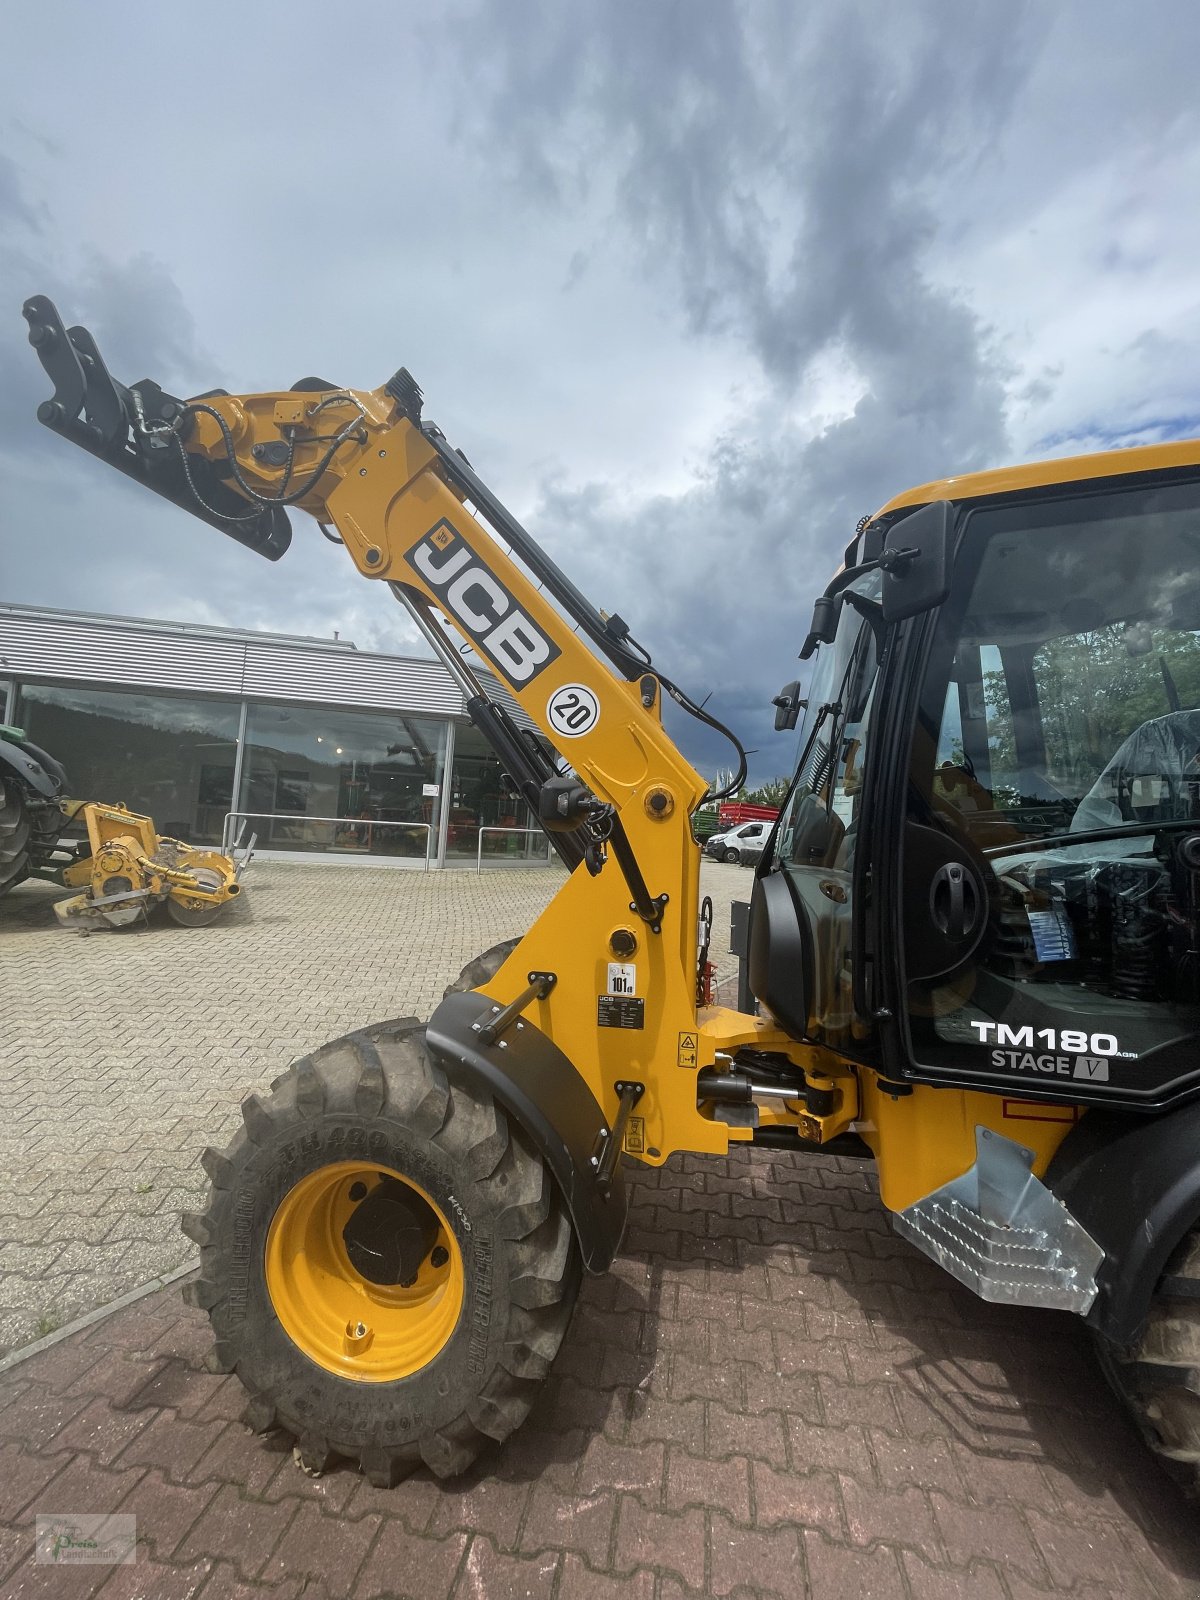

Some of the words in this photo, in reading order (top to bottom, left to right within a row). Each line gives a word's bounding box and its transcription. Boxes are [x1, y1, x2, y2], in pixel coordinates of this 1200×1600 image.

[413, 542, 550, 681] JCB
[554, 693, 591, 729] 20
[612, 976, 627, 993] 101
[970, 1020, 1118, 1056] TM180
[1116, 1051, 1138, 1059] AGRI
[991, 1050, 1070, 1075] STAGE
[1086, 1060, 1102, 1077] V
[469, 1232, 495, 1376] TRELLEBORG
